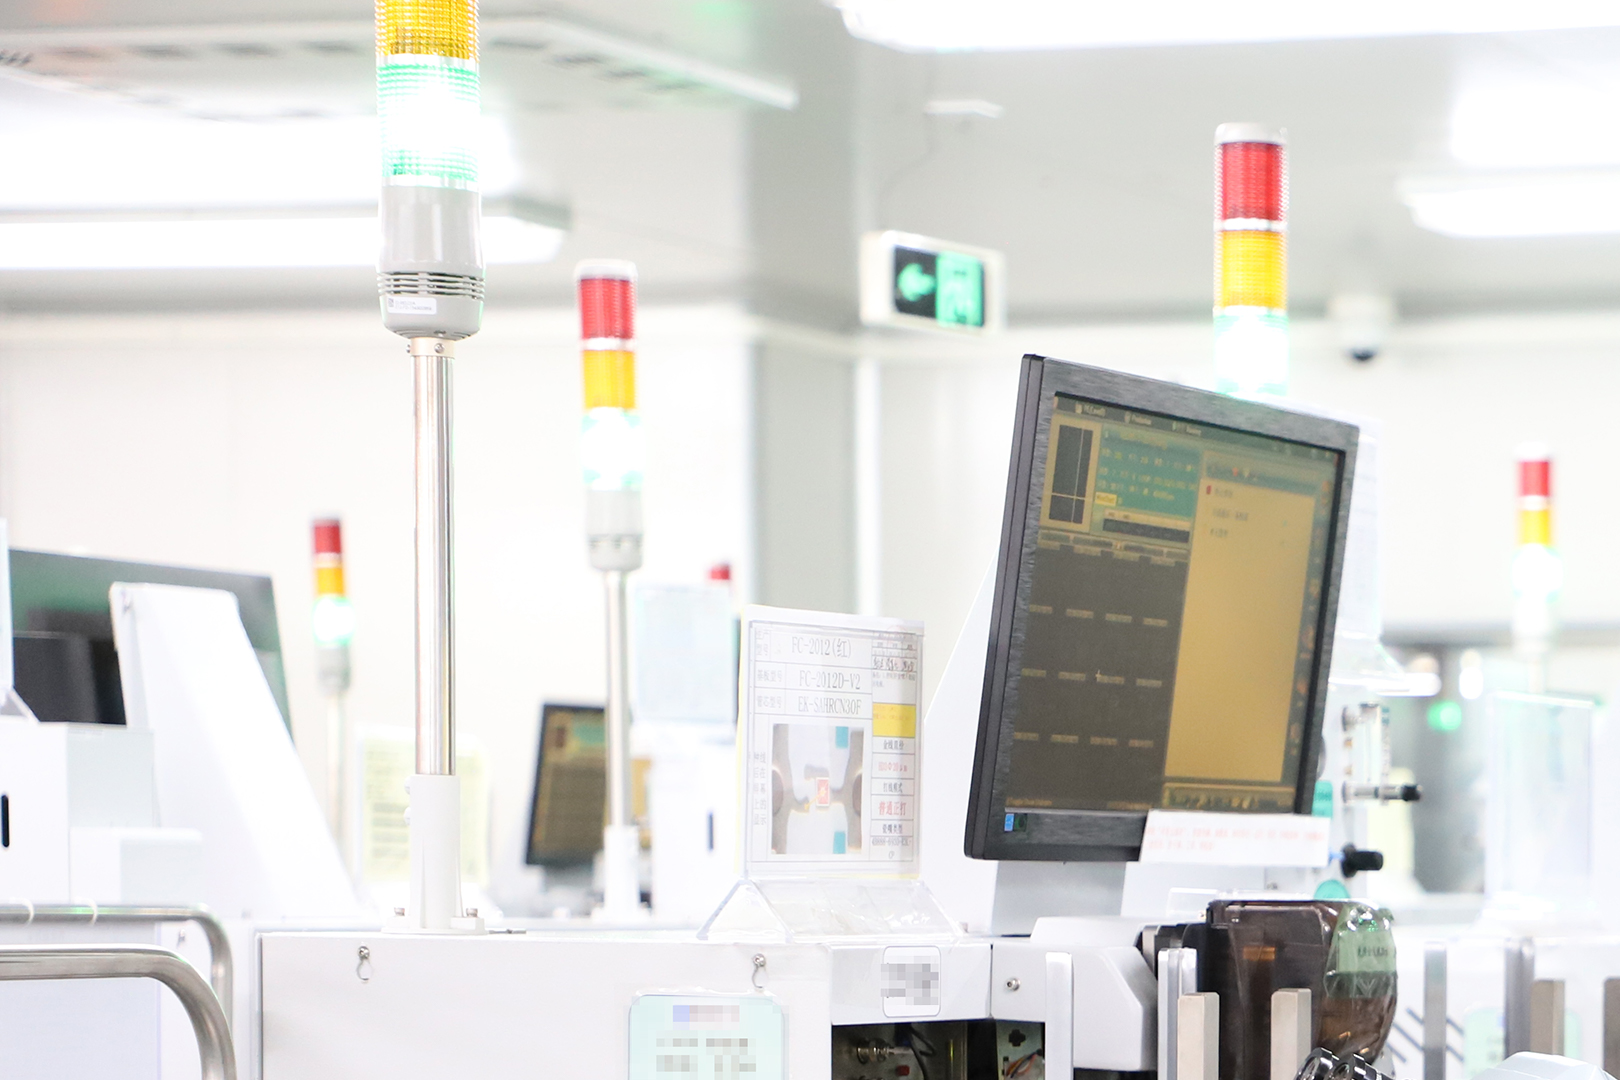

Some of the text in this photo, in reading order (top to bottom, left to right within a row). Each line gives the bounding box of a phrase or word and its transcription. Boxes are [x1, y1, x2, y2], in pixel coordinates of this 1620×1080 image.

[791, 636, 852, 659] FC-2012(红)
[757, 670, 782, 682] 基板型号
[799, 671, 861, 690] FC-2012D-V2
[878, 800, 907, 816] 普通正打
